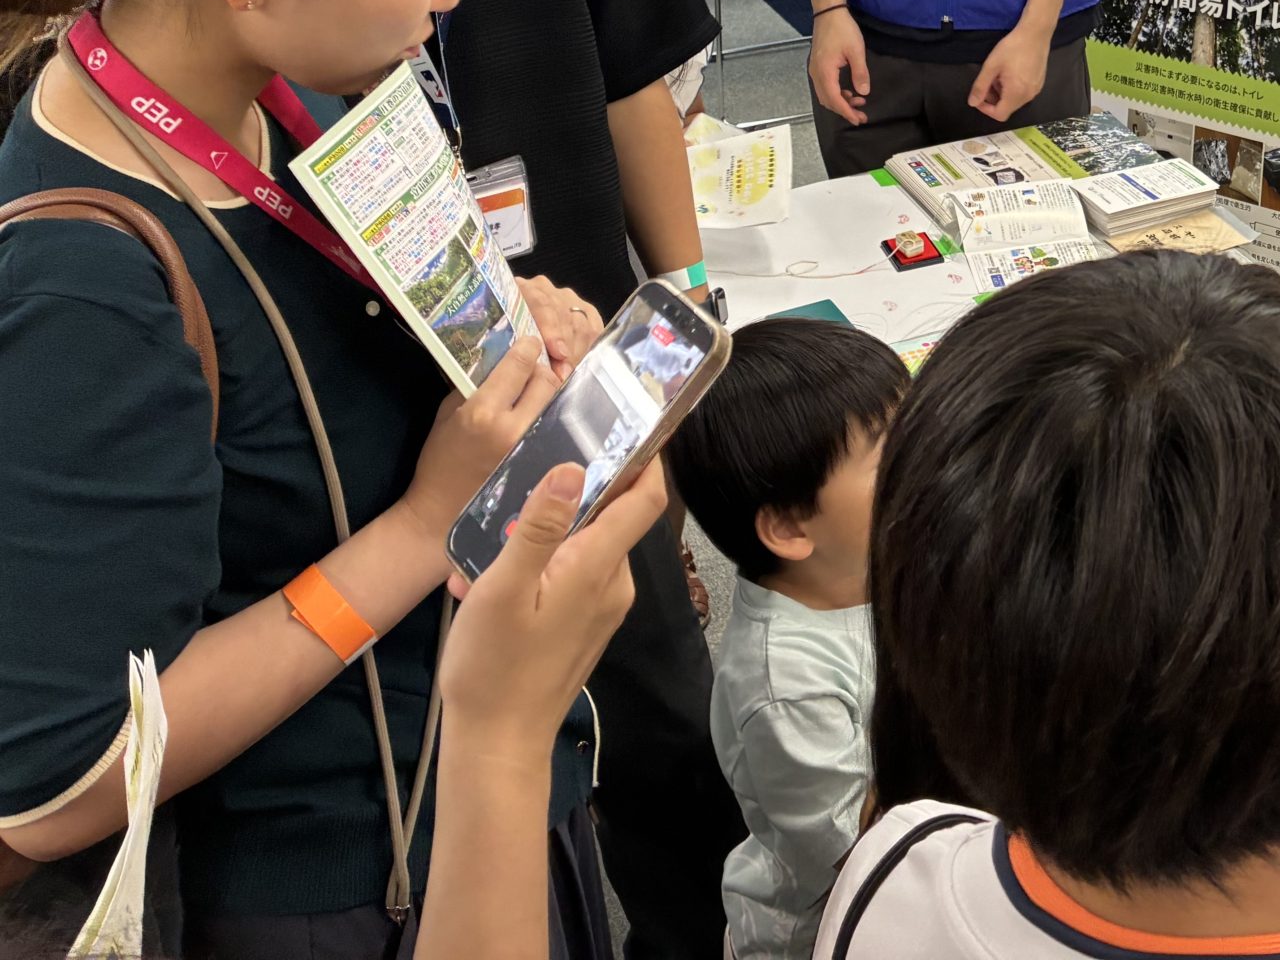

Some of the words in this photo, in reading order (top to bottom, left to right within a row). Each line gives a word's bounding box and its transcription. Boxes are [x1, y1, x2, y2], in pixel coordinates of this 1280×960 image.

[1135, 61, 1264, 101] 災害時にまず必要になるのは、トイレ
[131, 96, 183, 134] PEP
[253, 186, 293, 220] PEP
